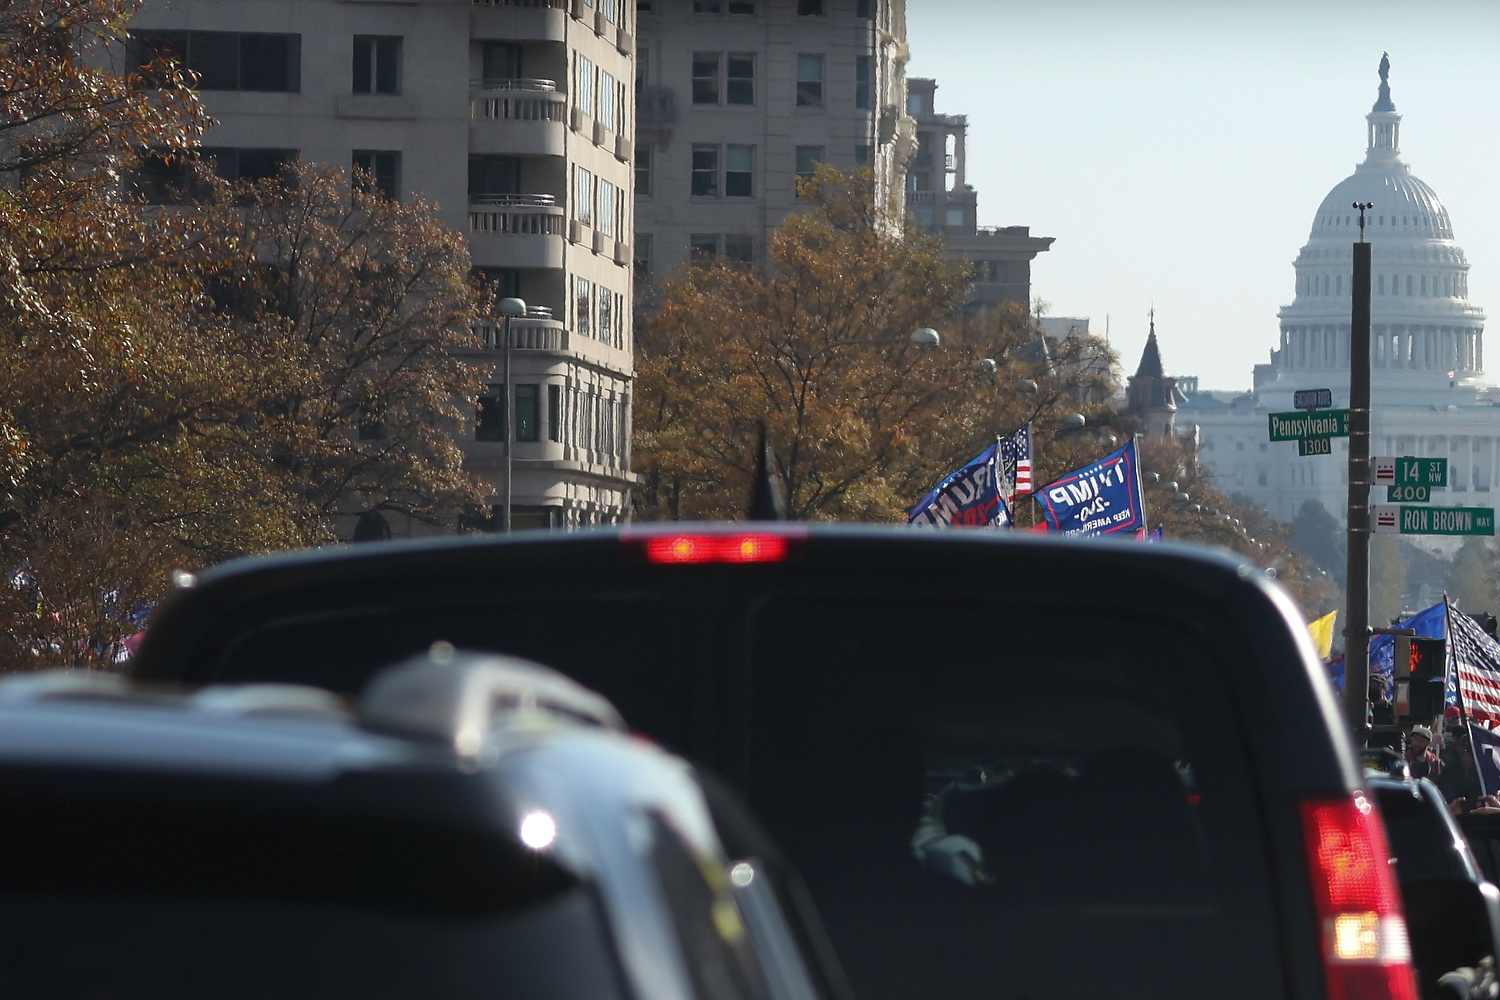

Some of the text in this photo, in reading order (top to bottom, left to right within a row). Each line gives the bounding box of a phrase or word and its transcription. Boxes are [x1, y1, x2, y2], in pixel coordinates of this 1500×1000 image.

[1272, 415, 1338, 438] Pennsylvania
[1303, 439, 1329, 454] 1300
[1402, 461, 1420, 482] 14
[1430, 461, 1441, 472] ST
[1428, 472, 1442, 483] NW
[1392, 486, 1427, 501] 400
[1404, 510, 1491, 531] RON BROWN WAY
